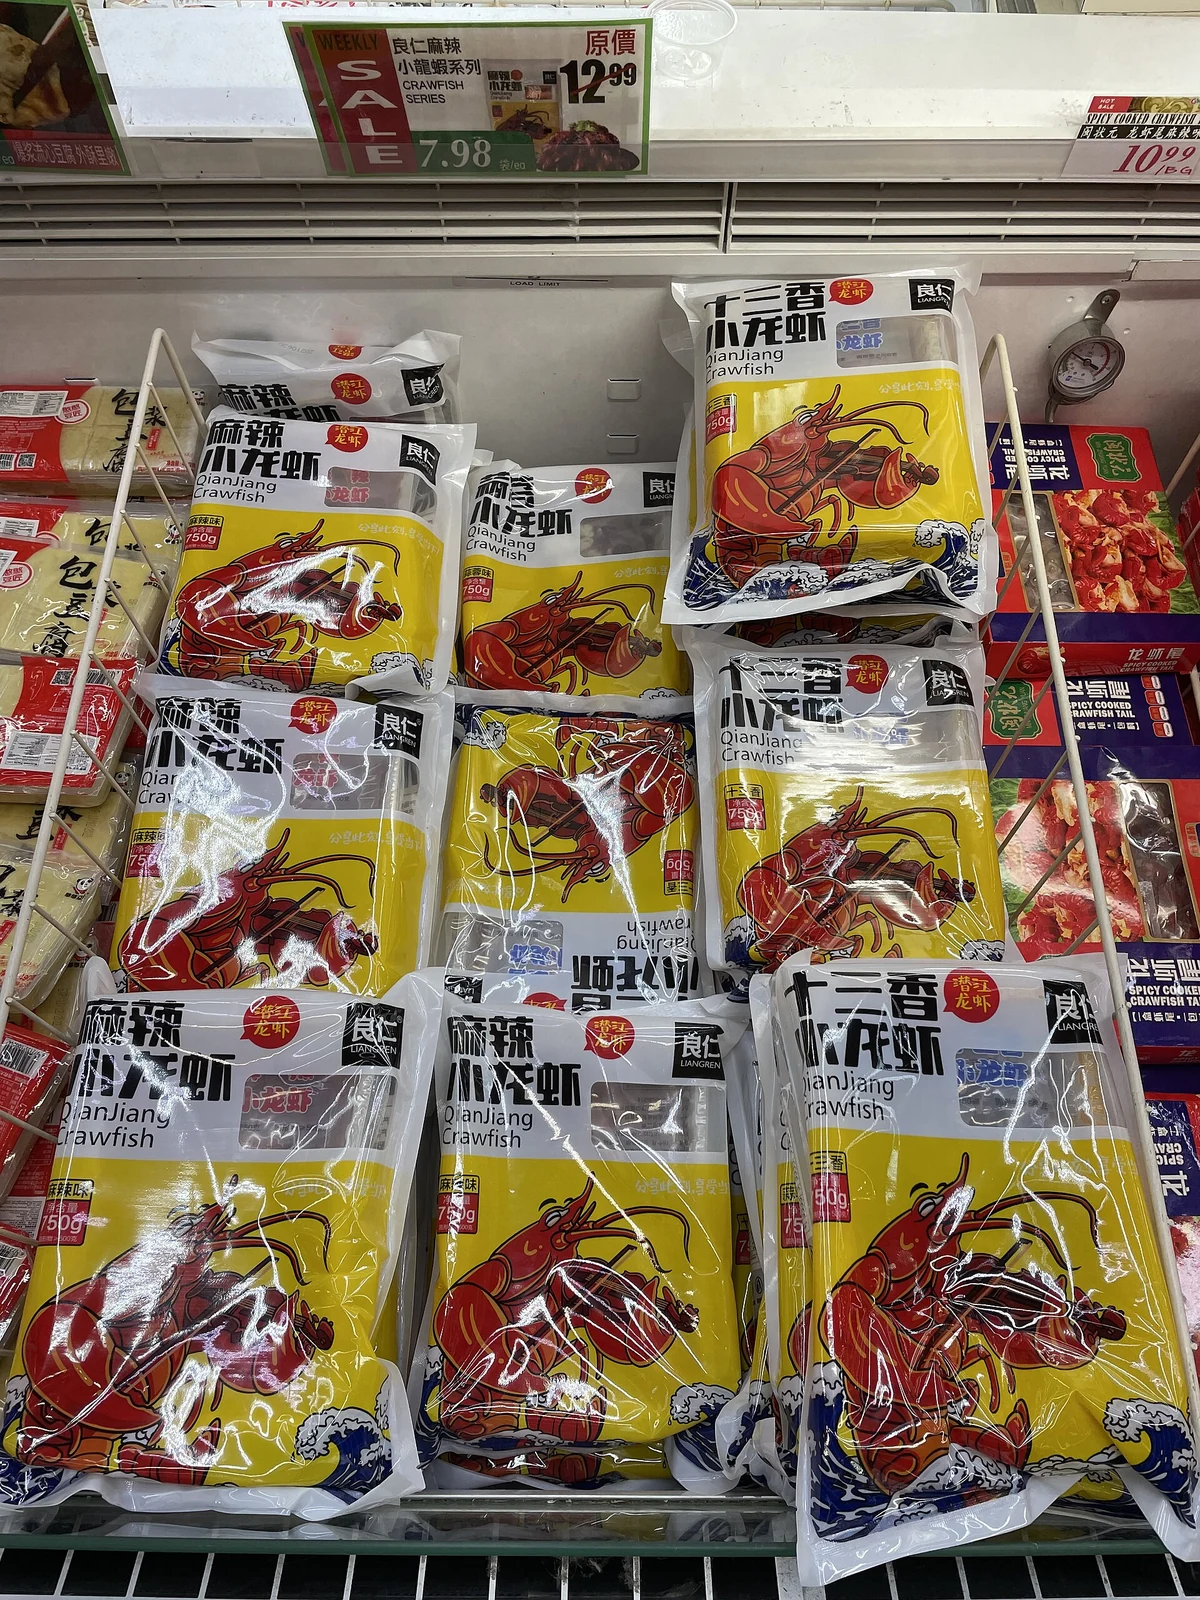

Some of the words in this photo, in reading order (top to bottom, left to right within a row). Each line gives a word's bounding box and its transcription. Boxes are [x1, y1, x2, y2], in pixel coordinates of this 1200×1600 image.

[318, 34, 378, 50] WEEKLY
[392, 37, 462, 55] 良仁麻辣
[585, 29, 636, 57] 原價
[398, 58, 481, 76] 小龍蝦系列
[402, 80, 464, 90] CRAWFISH
[405, 94, 446, 104] SERIES
[1085, 113, 1112, 125] SPICY
[1113, 113, 1150, 125] COOKED
[1151, 113, 1198, 125] CRAWFISH
[419, 138, 491, 168] 7.98
[704, 281, 826, 318] 十三香
[838, 289, 866, 299] 龙虾
[917, 283, 951, 298] 良仁
[706, 311, 826, 353] 小龙虾
[706, 349, 784, 370] QianJiang
[706, 362, 775, 384] Crawfish
[221, 384, 297, 411] 麻辣
[206, 418, 286, 449] 麻辣
[334, 434, 362, 448] 龙虾
[199, 446, 322, 482] 小龙虾
[407, 441, 436, 469] 良仁
[196, 474, 278, 494] QianJiang
[193, 487, 266, 503] Crawfish
[469, 495, 573, 538] 小龙虾
[185, 533, 217, 545] 750g
[467, 526, 537, 552] QianJiang
[466, 538, 527, 562] Crawfish
[463, 584, 490, 597] 750g
[719, 657, 842, 698] 十三香
[855, 670, 883, 687] 龙虾
[931, 669, 967, 690] 良仁
[156, 698, 242, 734] 麻辣
[720, 691, 845, 734] 小龙虾
[1072, 710, 1114, 718] RAWFISH
[1115, 710, 1136, 718] TAIL
[1094, 702, 1132, 710] COOKED
[383, 712, 417, 736] 良仁
[721, 730, 803, 750] QianJiang
[145, 732, 285, 776] 小龙虾
[721, 747, 794, 766] Crawfish
[952, 977, 990, 993] 潜江
[1129, 985, 1161, 996] SPICY
[1162, 984, 1200, 996] COOKE
[784, 971, 939, 1022] 十三香
[954, 992, 992, 1012] 龙虾
[1131, 996, 1185, 1006] CRAWFISH
[79, 1000, 185, 1047] 麻辣
[253, 1019, 290, 1039] 龙虾
[351, 1016, 397, 1042] 良仁
[1057, 1022, 1099, 1032] LIANGRE
[447, 1015, 534, 1059] 麻辣
[681, 1032, 721, 1059] 良仁
[794, 1020, 945, 1076] 小龙虾
[680, 1059, 721, 1070] LIANGREN
[68, 1052, 236, 1102] 小龙虾
[446, 1059, 581, 1107] 小龙虾
[444, 1106, 534, 1132] QianJiang
[803, 1098, 885, 1121] rawfish
[442, 1128, 522, 1149] Crawfish
[1157, 1154, 1184, 1166] SPIC
[811, 1189, 846, 1210] 50g
